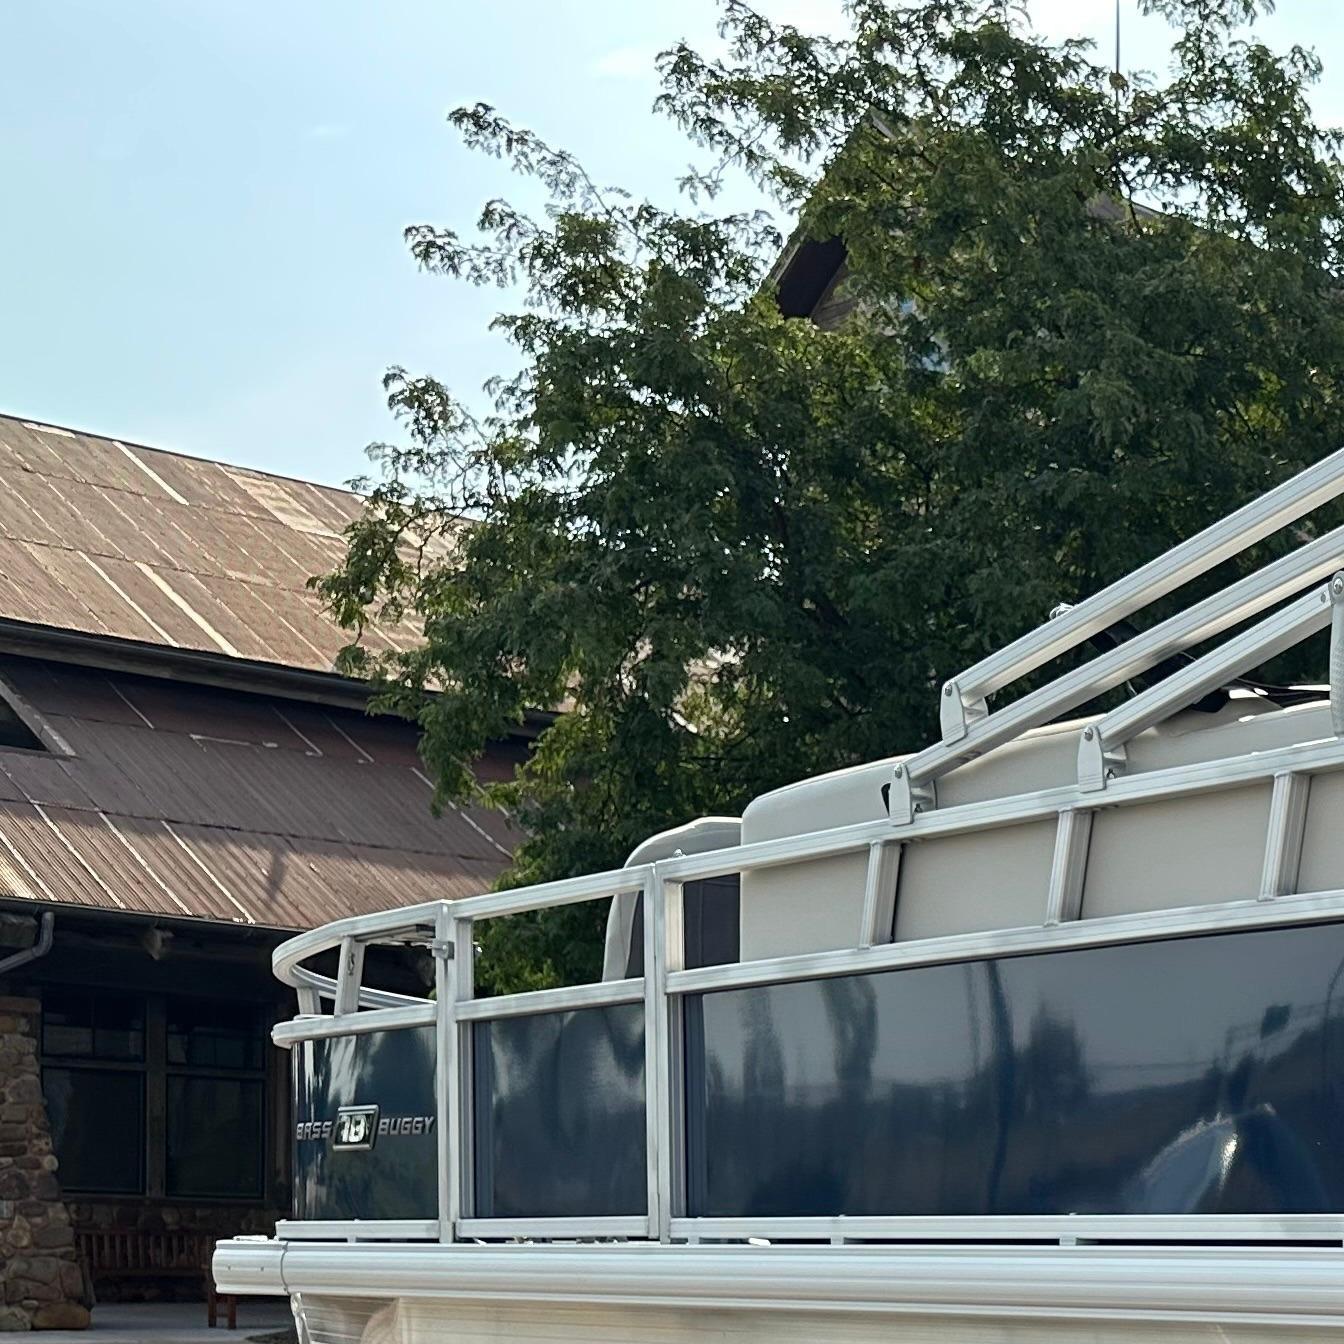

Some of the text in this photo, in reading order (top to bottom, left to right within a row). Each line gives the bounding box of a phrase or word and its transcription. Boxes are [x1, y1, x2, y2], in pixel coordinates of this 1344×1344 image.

[296, 1114, 435, 1143] BASS 18 BUGGY
